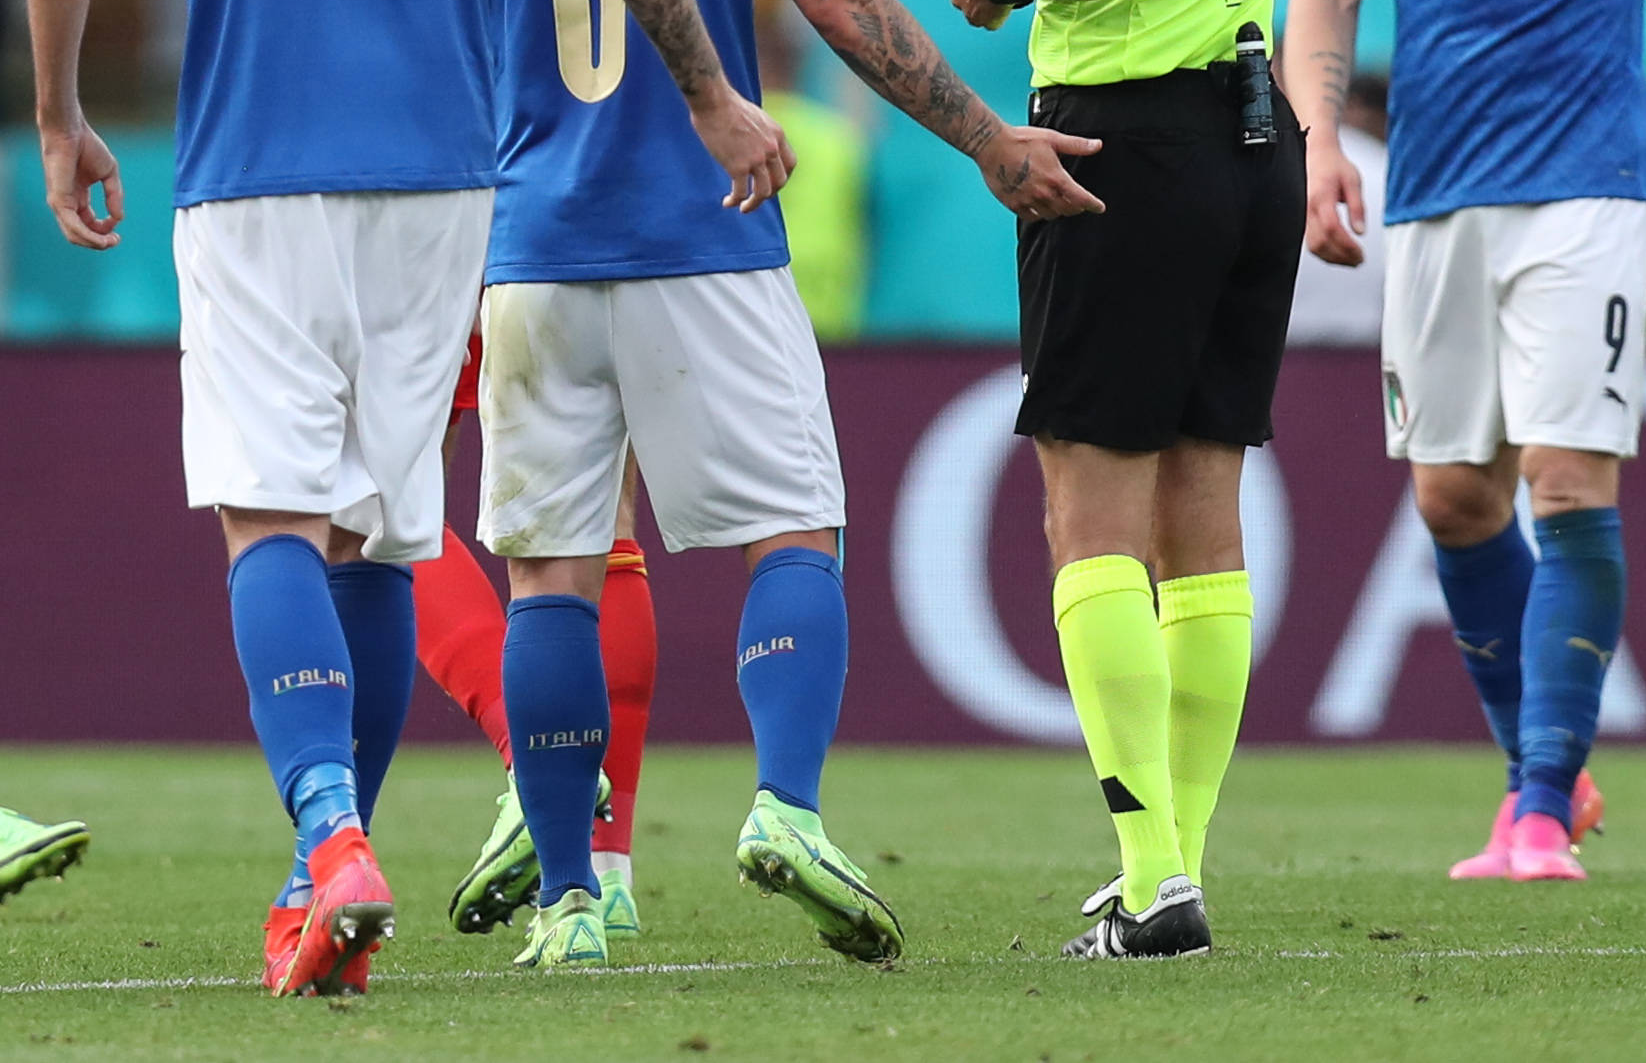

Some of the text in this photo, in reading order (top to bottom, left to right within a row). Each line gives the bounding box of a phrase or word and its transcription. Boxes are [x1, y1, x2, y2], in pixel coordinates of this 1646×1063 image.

[1606, 293, 1628, 373] 9
[739, 636, 796, 668] TALIA
[273, 668, 347, 695] ITALIA
[529, 729, 603, 750] ITALIA
